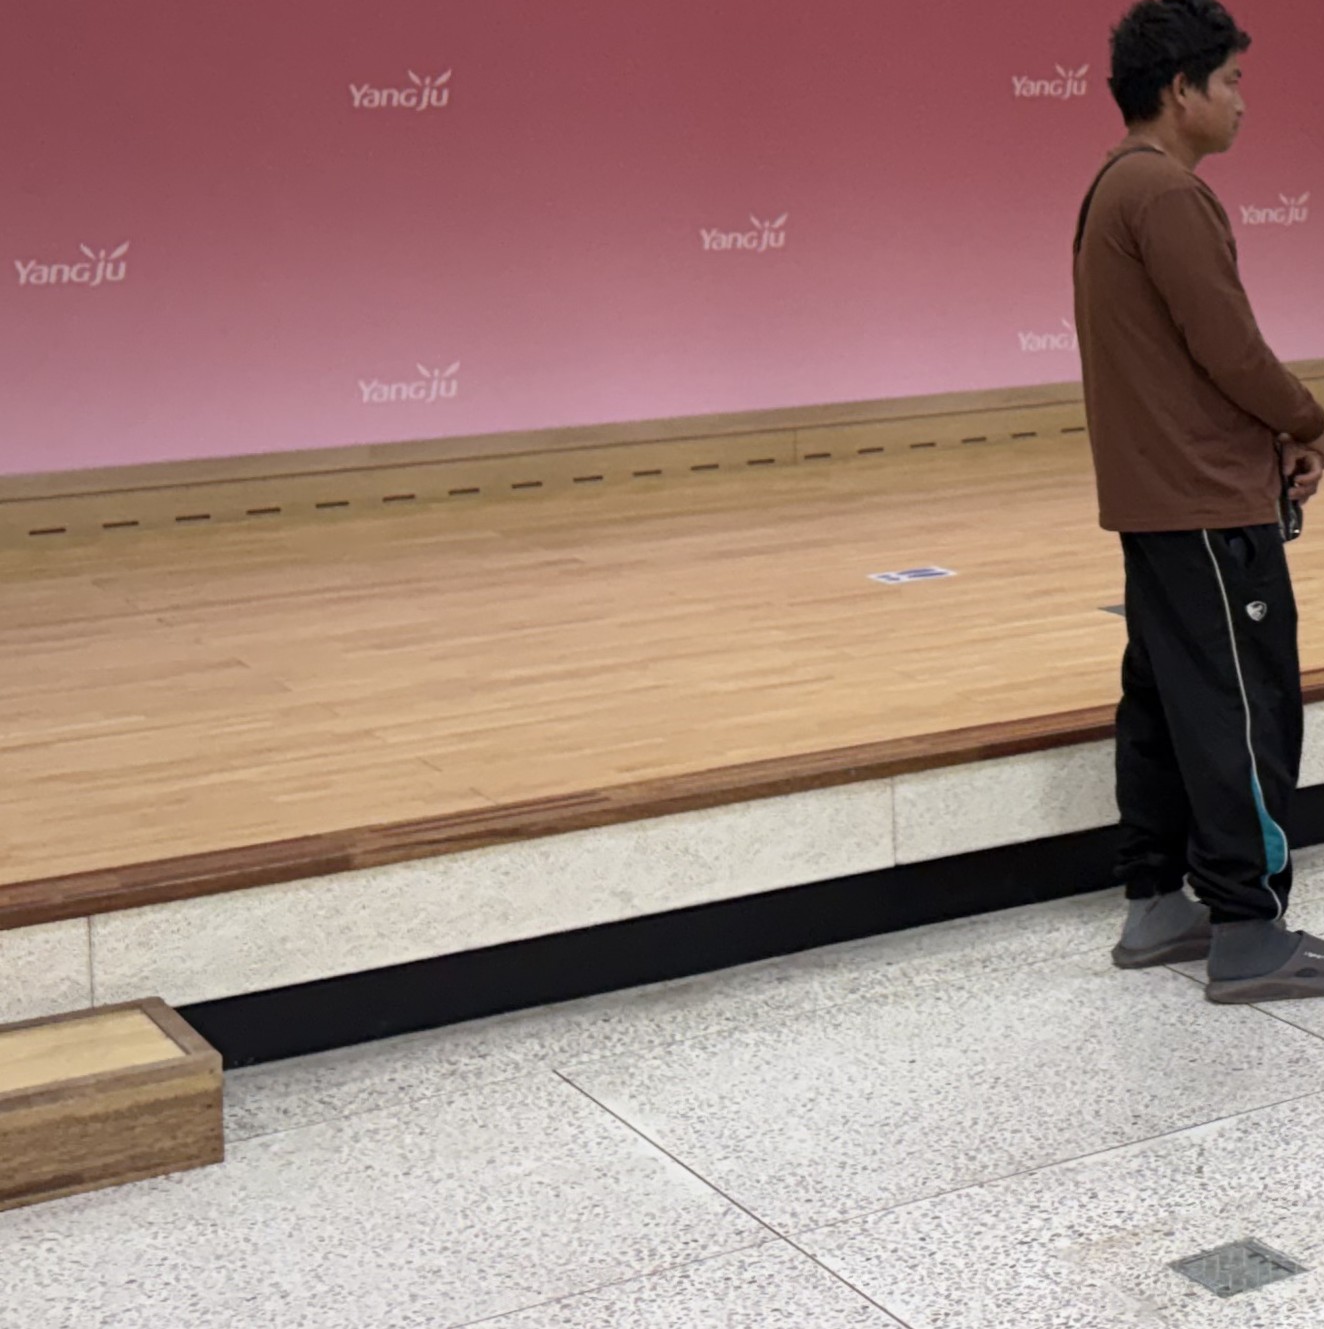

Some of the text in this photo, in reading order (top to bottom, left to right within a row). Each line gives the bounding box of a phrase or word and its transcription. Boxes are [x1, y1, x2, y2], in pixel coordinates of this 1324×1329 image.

[350, 76, 450, 112] Yangju
[1012, 71, 1088, 100] Yangju
[1240, 198, 1308, 227] Yangju
[701, 220, 787, 253] Yangju
[15, 248, 128, 287] Yangju
[360, 368, 459, 404] Yangju
